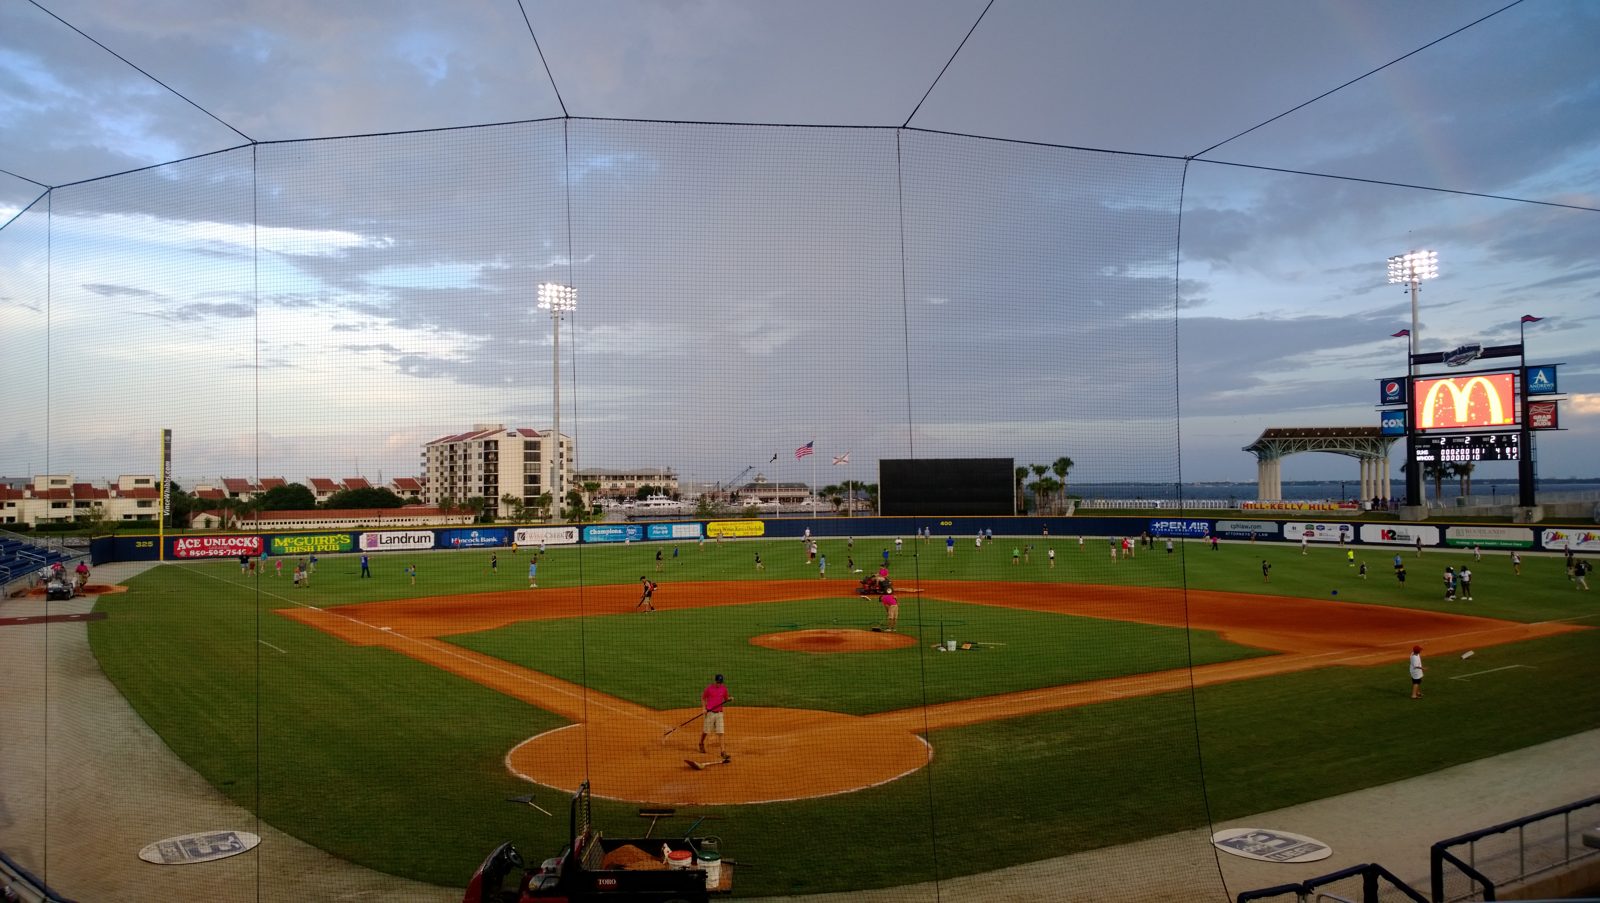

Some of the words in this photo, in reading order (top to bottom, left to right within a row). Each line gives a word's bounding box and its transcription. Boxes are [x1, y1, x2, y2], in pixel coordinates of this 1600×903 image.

[1308, 503, 1335, 511] HILL
[1160, 521, 1187, 529] PEN
[1188, 522, 1209, 530] AIR
[379, 533, 431, 545] Landrum
[1381, 529, 1396, 540] K2
[177, 539, 201, 550] ACE
[203, 537, 258, 548] UNLOCKS
